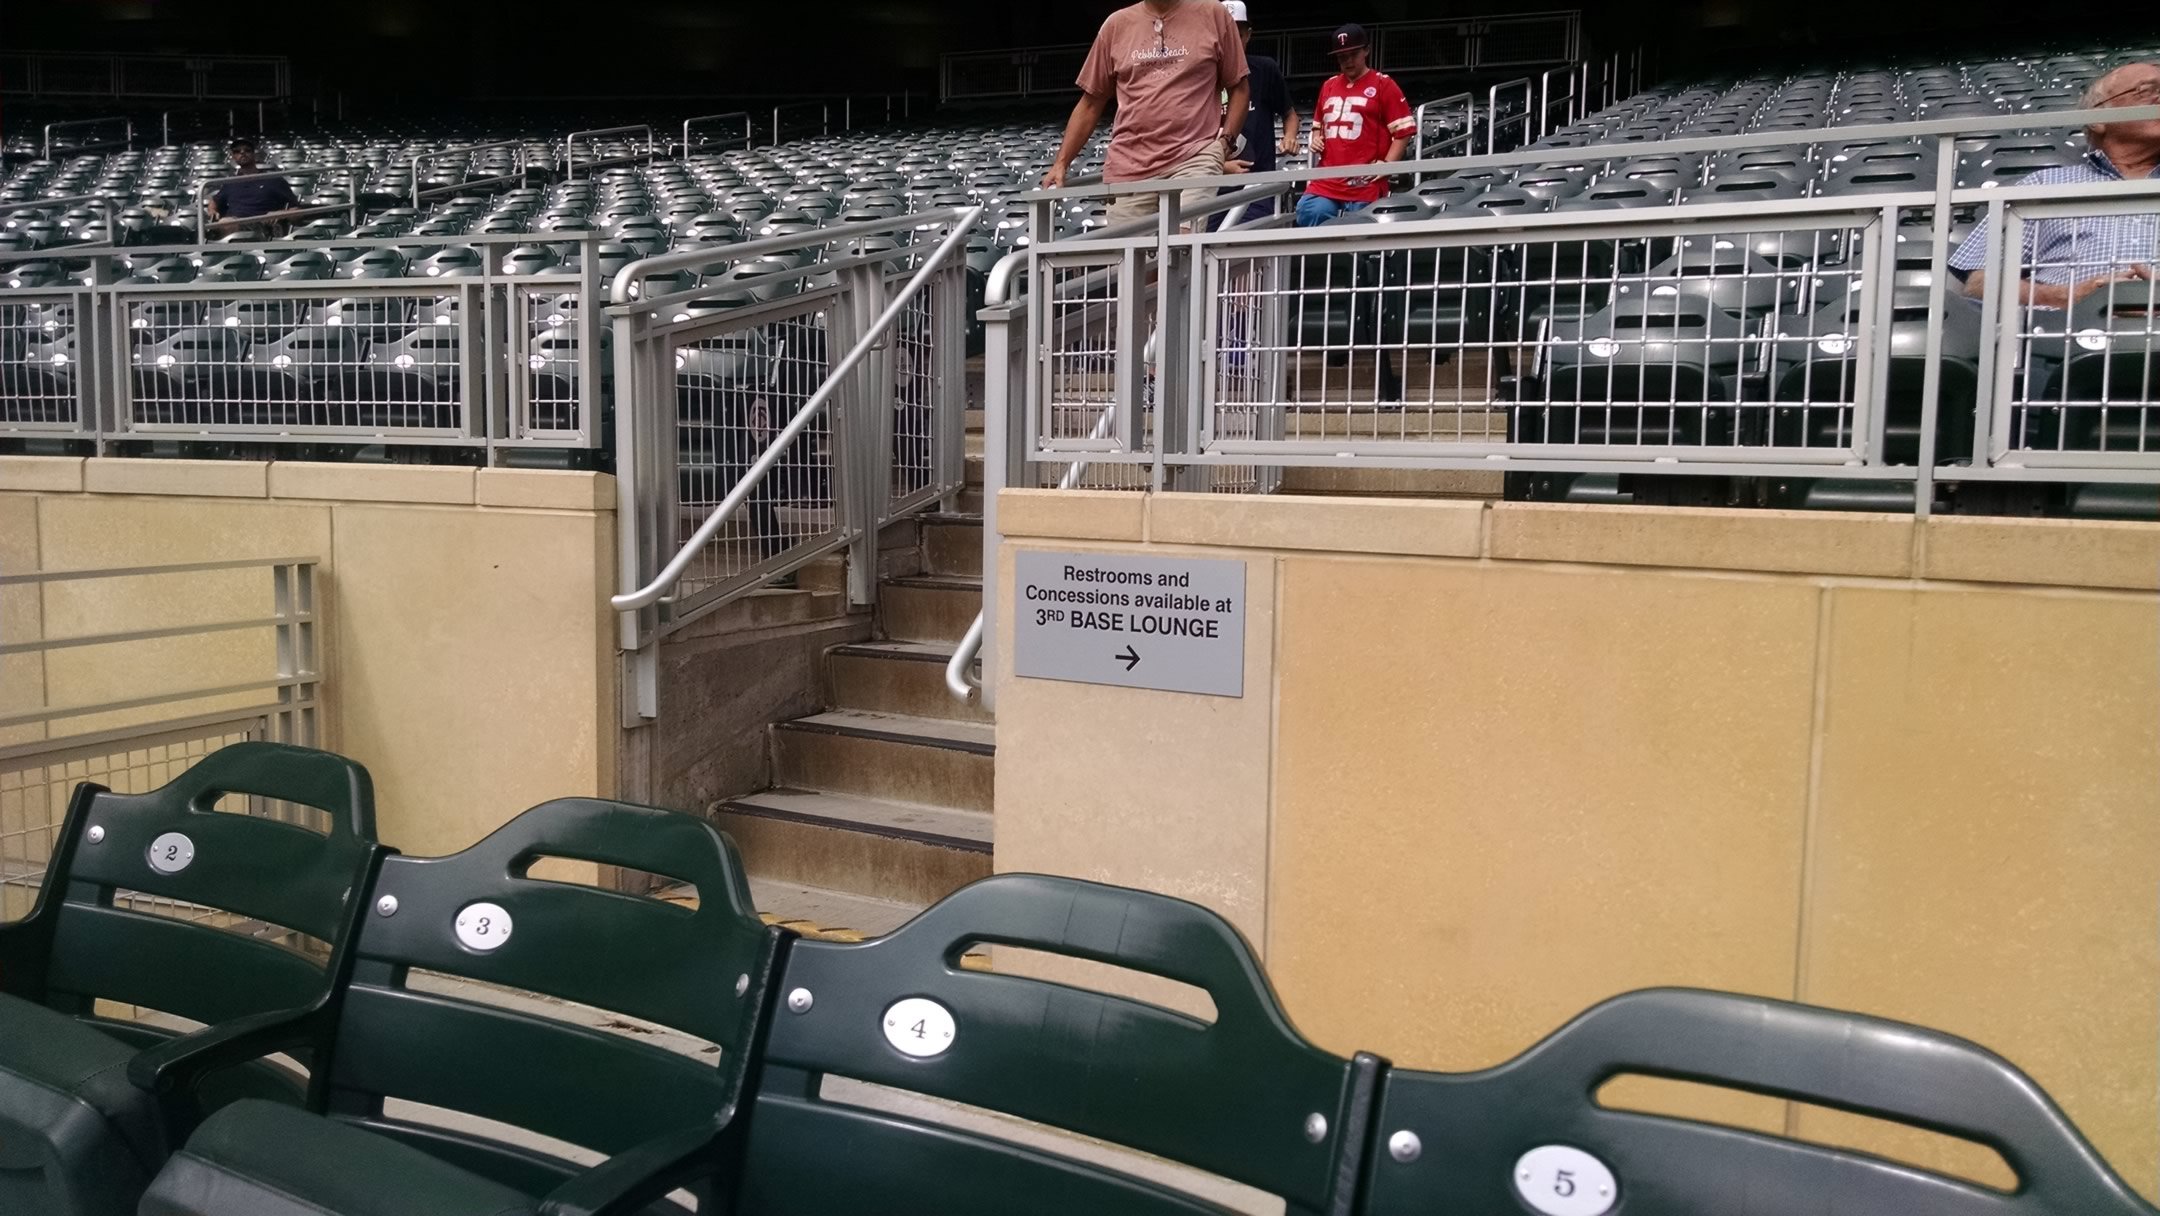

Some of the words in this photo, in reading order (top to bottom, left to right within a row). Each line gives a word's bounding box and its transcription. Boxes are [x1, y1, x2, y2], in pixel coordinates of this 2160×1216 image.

[1337, 32, 1348, 45] T
[1131, 47, 1162, 61] Pebble
[1162, 44, 1190, 58] Beach
[1322, 96, 1368, 140] 25
[1063, 565, 1152, 586] Restrooms
[1157, 572, 1190, 588] and
[1026, 584, 1130, 607] Concessions
[1134, 594, 1210, 612] available
[1215, 597, 1232, 613] at
[1036, 608, 1065, 626] 3RD
[1070, 610, 1124, 632] BASE
[1130, 614, 1219, 638] LOUNGE
[165, 845, 178, 861] 2
[476, 917, 491, 935] 3
[911, 1019, 926, 1039] 4
[1554, 1168, 1575, 1197] 5
